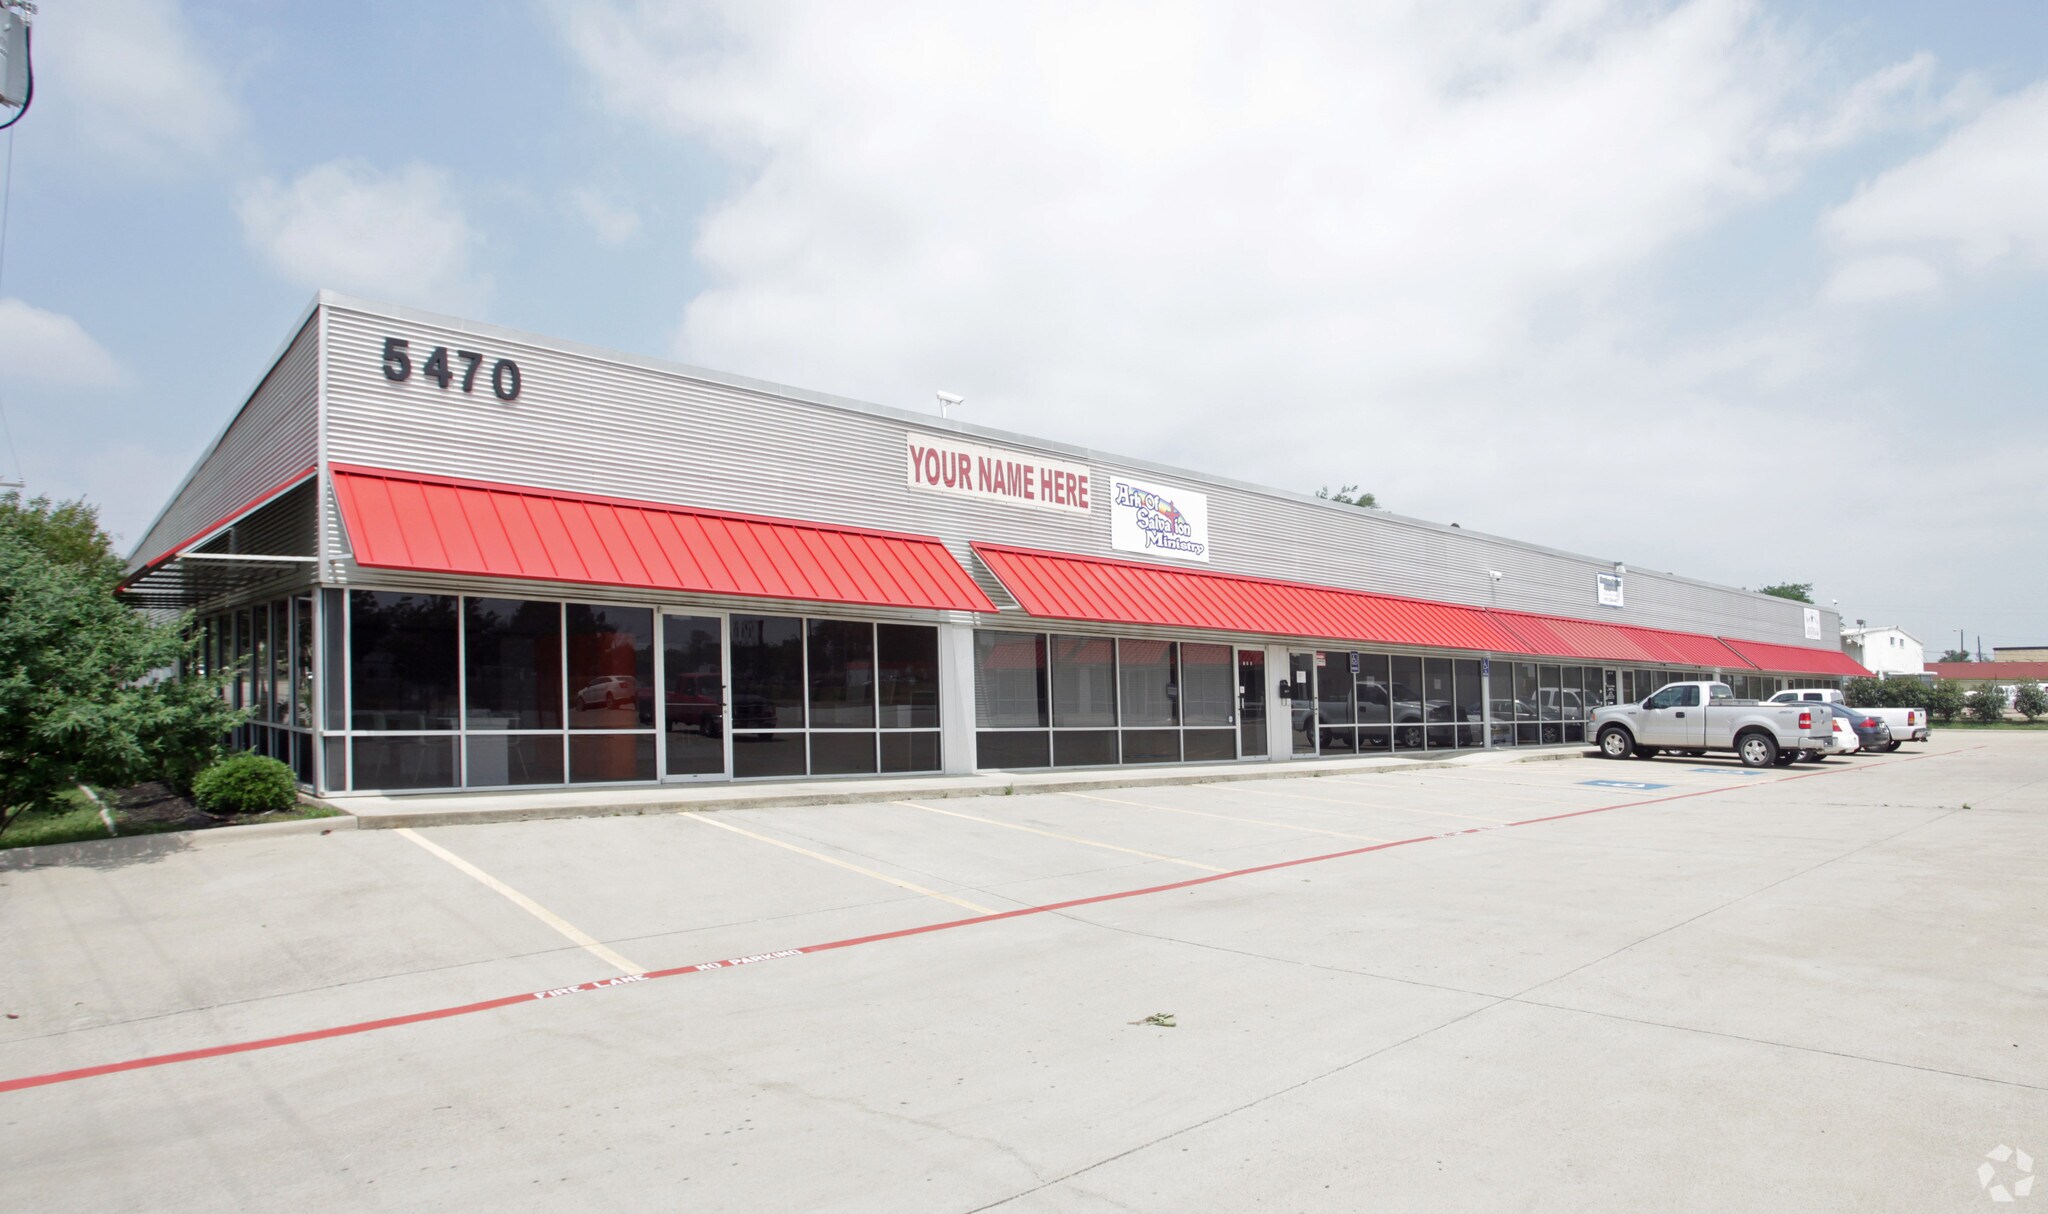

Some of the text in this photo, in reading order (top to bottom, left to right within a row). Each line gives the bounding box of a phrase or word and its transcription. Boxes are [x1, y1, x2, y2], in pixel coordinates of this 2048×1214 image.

[383, 337, 521, 401] 5470
[909, 445, 1090, 509] YOUR NAME HERE
[1115, 482, 1161, 511] Ark Of
[1145, 530, 1204, 555] Ministry
[695, 949, 803, 971] NO PARKING
[534, 973, 649, 999] FIRE LANE
